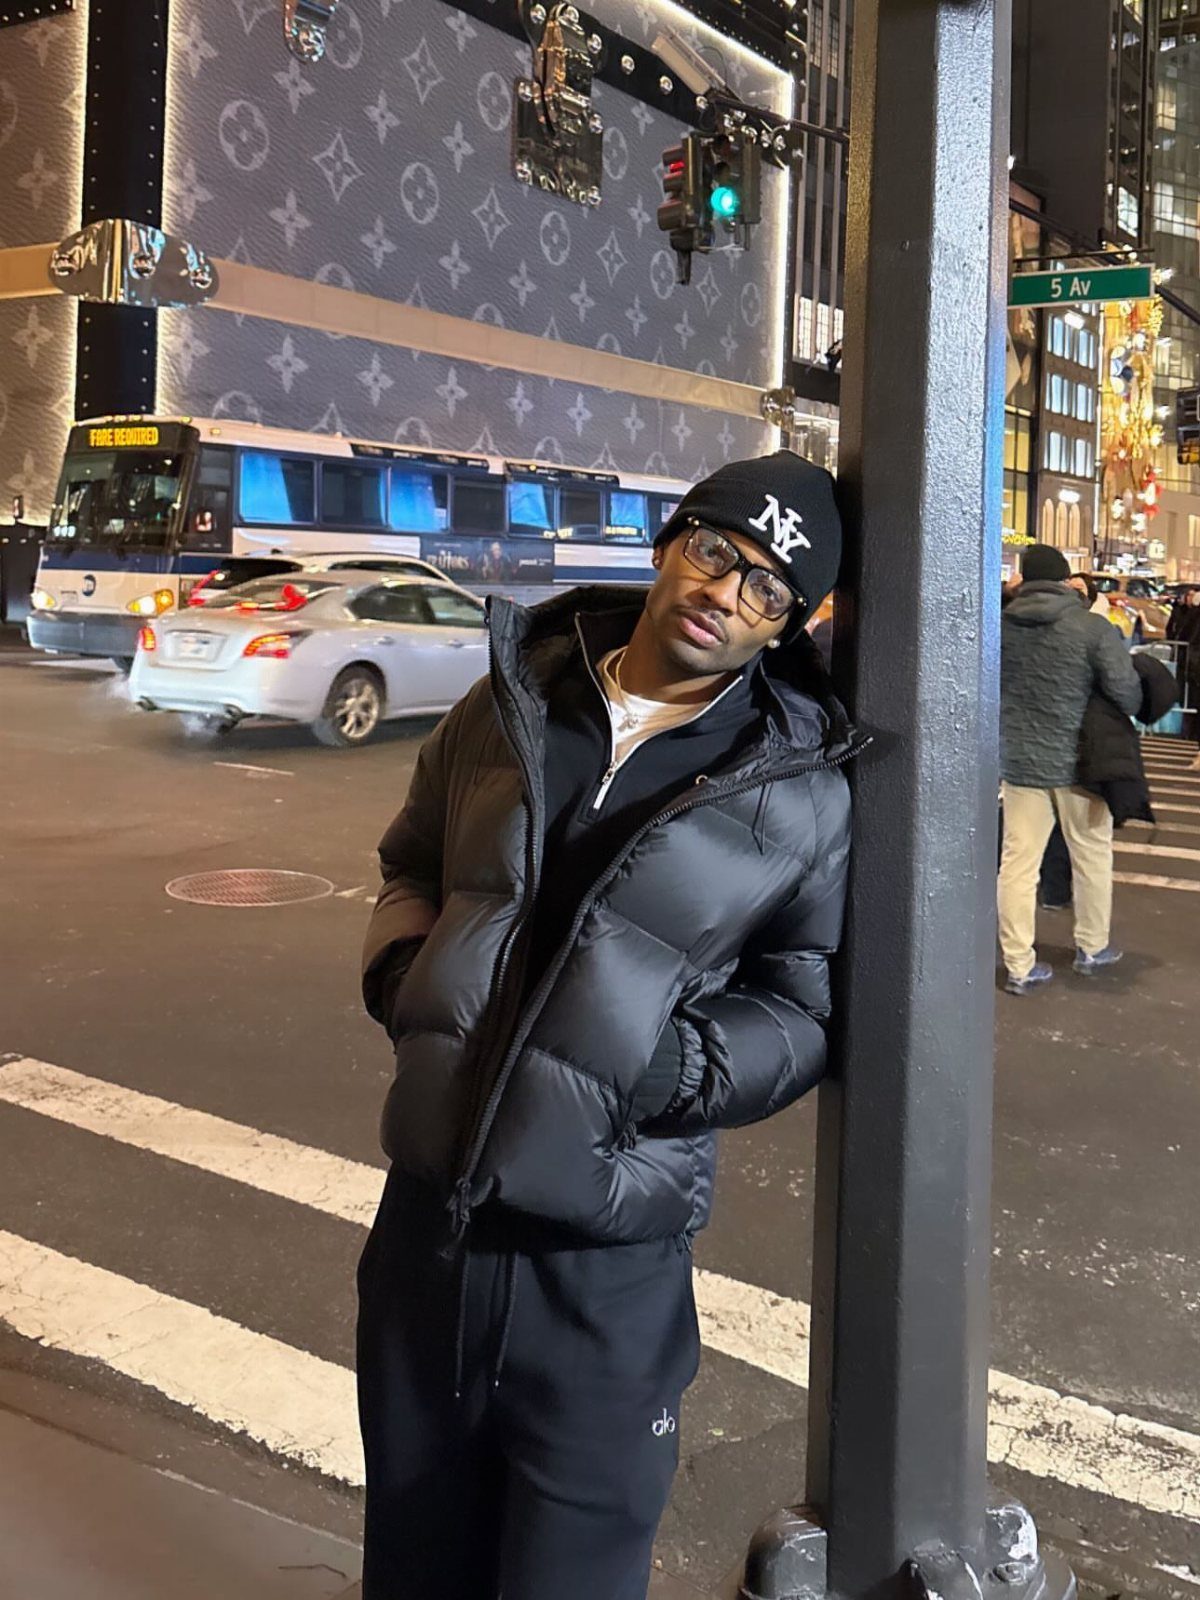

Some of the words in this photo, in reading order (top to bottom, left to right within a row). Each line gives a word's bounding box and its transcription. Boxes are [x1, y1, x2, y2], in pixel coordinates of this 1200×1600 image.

[1051, 278, 1062, 298] 5
[1069, 276, 1091, 297] Av
[89, 428, 113, 446] FARE
[114, 426, 159, 446] REQUIRED
[748, 493, 811, 564] NY
